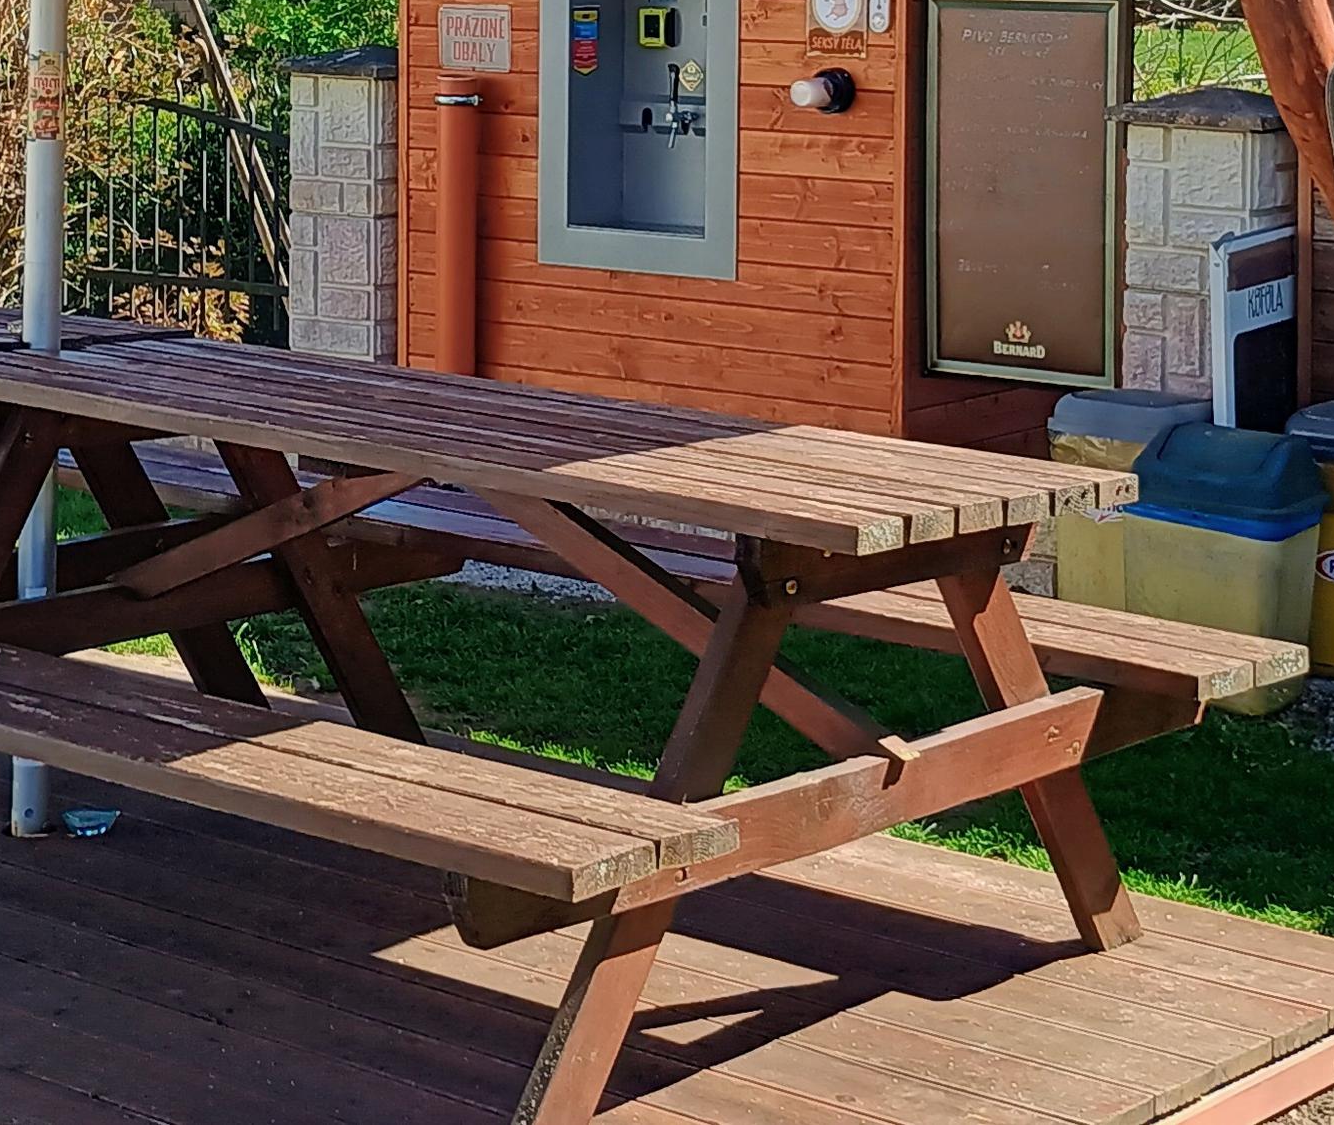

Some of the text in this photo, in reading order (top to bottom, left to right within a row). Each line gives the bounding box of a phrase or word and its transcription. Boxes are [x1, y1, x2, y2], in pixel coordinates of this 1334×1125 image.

[453, 40, 496, 63] OBALY
[811, 35, 840, 49] SEKSY
[1247, 281, 1284, 319] KOFOLA
[993, 340, 1046, 359] BERNARD
